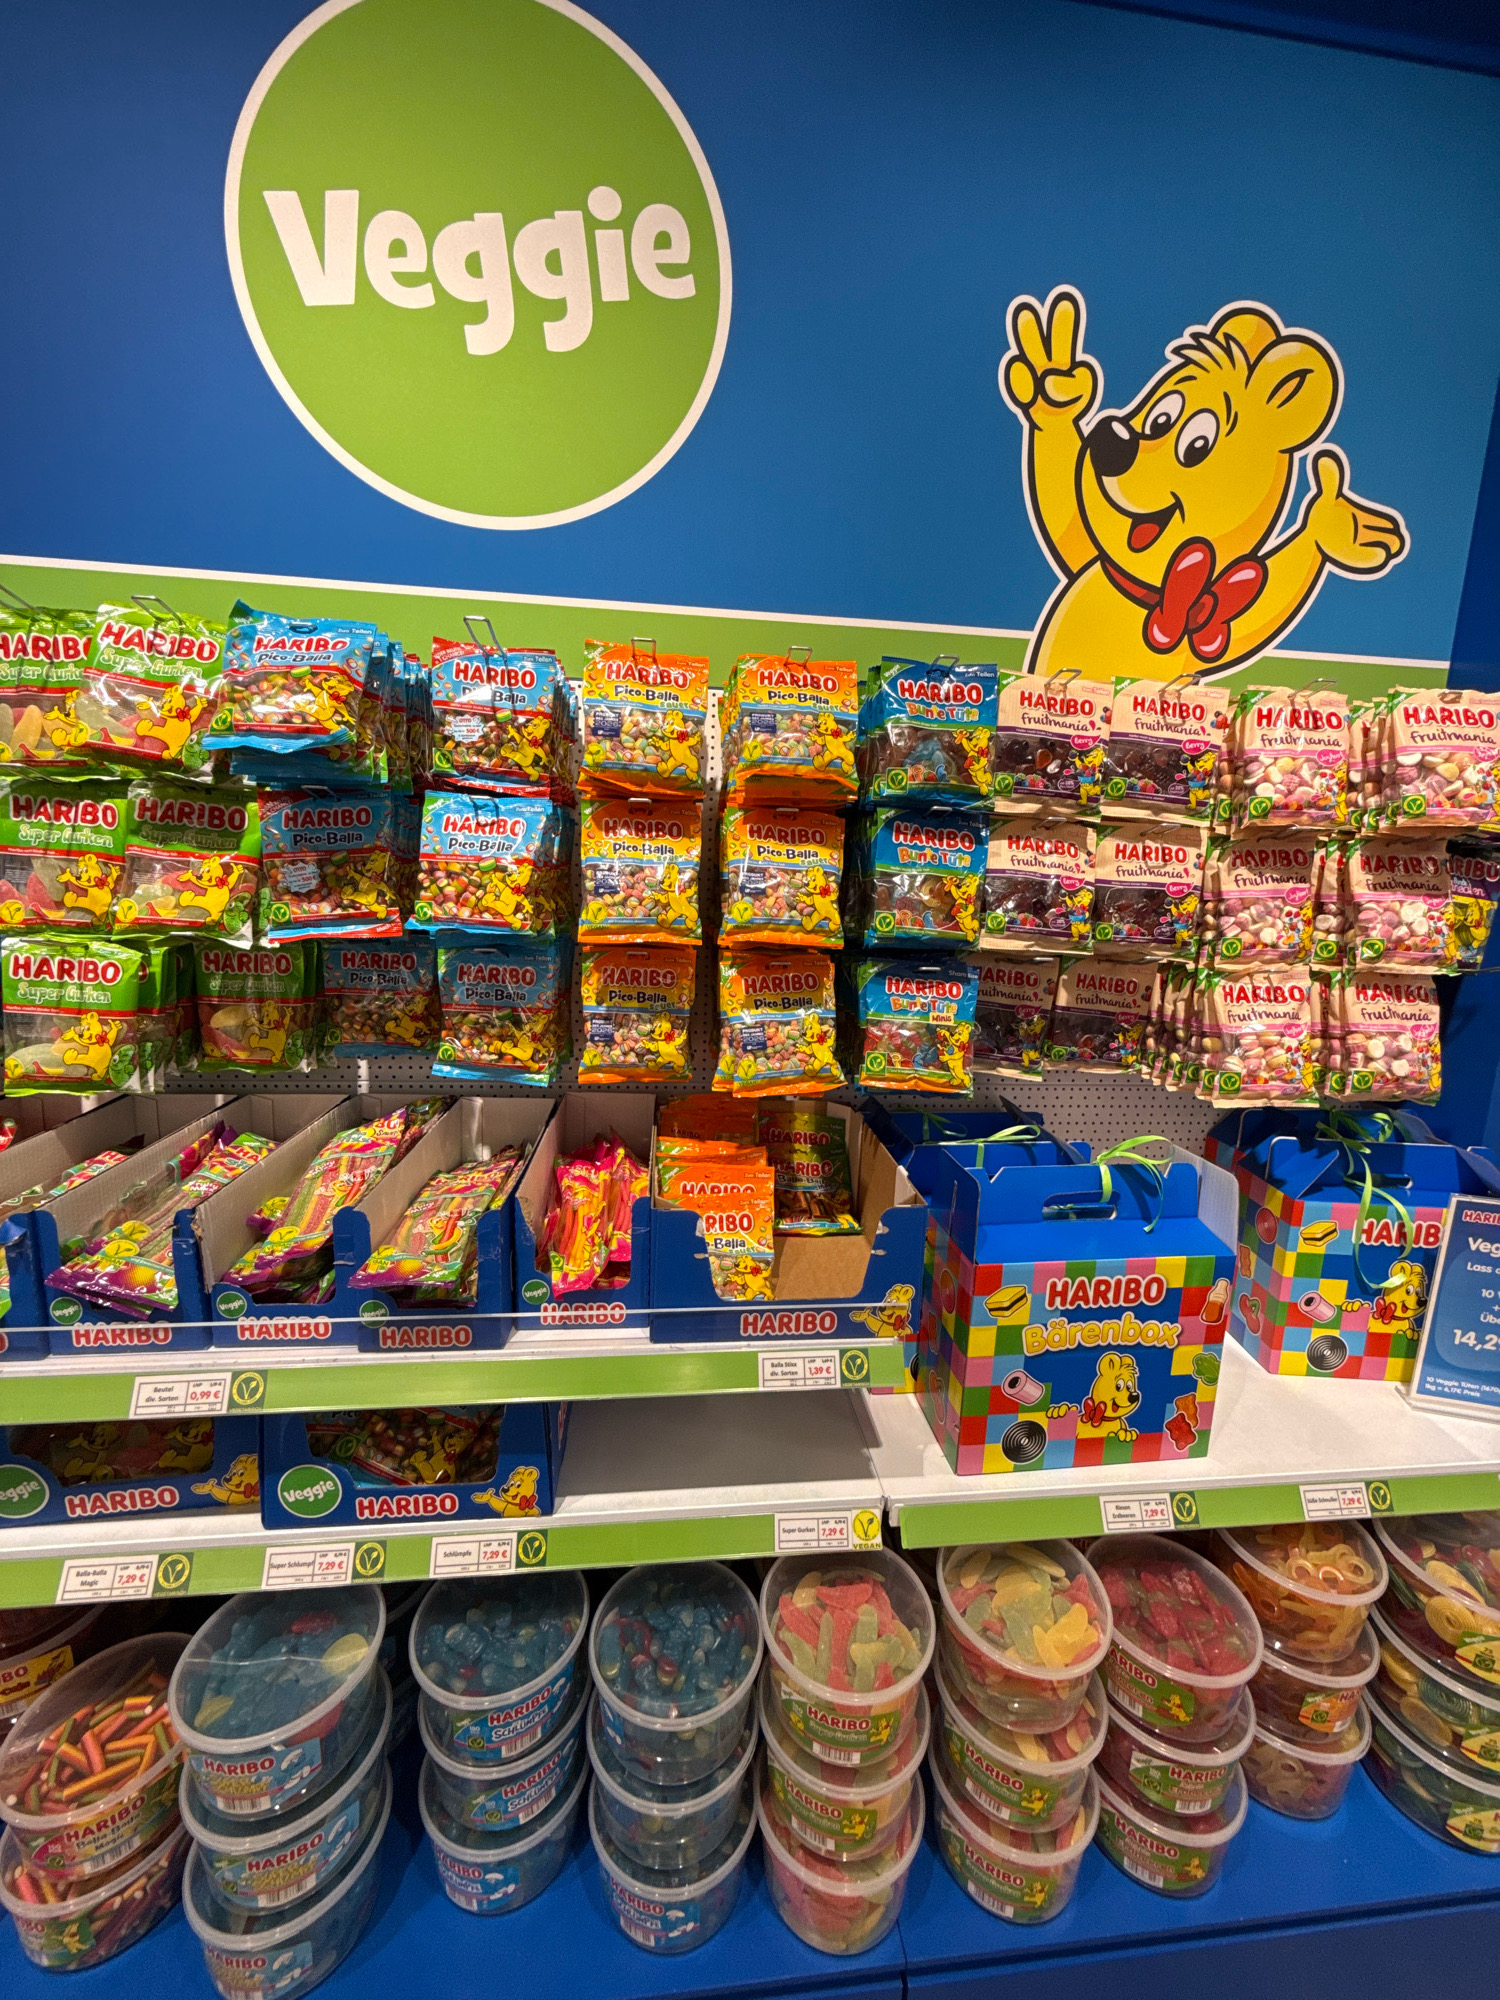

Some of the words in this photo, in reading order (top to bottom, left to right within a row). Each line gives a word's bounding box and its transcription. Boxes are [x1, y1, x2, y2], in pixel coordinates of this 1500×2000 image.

[263, 186, 696, 355] Veggie
[98, 621, 219, 662] HARIBO
[253, 636, 350, 653] HARIBO
[101, 648, 150, 672] Super
[151, 660, 202, 678] Gurken
[257, 653, 332, 663] Pico-Balla
[453, 661, 537, 689] HARIBO
[605, 661, 691, 690] HARIBO
[757, 669, 839, 694] HARIBO
[613, 684, 680, 703] Pico-Balla
[767, 690, 830, 706] Pico-Balla
[897, 679, 983, 704] HARIBO
[906, 701, 946, 720] Bunte
[947, 706, 979, 722] Tüte
[1019, 690, 1094, 717] HARIBO
[1132, 695, 1206, 722] HARIBO
[1021, 713, 1090, 732] fruitmania
[1135, 718, 1202, 736] fruitmania
[1256, 706, 1344, 731] HARIBO
[1403, 705, 1496, 729] HARIBO
[1074, 735, 1094, 746] Berry
[1185, 741, 1205, 752] Berry
[1260, 733, 1342, 748] fruitmania
[1410, 731, 1497, 746] fruitmania
[11, 794, 119, 829] HARIBO
[136, 796, 248, 831] HARIBO
[282, 806, 371, 830] HARIBO
[18, 823, 58, 844] Super
[60, 827, 113, 848] Gurken
[443, 815, 527, 837] HARIBO
[602, 818, 684, 841] HARIBO
[747, 823, 827, 846] HARIBO
[892, 820, 976, 851] HARIBO
[292, 831, 363, 847] Pico-Balla
[448, 837, 513, 853] Pico-Balla
[612, 841, 675, 856] Pico-Balla
[1007, 834, 1080, 860] HARIBO
[756, 845, 819, 861] Pico-Balla
[897, 847, 938, 865] Bunte
[939, 850, 971, 867] Tüte
[1114, 841, 1188, 865] HARIBO
[1230, 848, 1311, 871] HARIBO
[1010, 855, 1076, 874] fruitmania
[1116, 864, 1185, 880] fruitmania
[1360, 853, 1439, 877] HARIBO
[1063, 877, 1081, 889] Berry
[1169, 884, 1189, 895] Berry
[1234, 873, 1309, 888] fruitmania
[1366, 878, 1443, 893] fruitmania
[11, 953, 123, 986] HARIBO
[203, 950, 293, 976] HARIBO
[341, 950, 417, 972] HARIBO
[350, 972, 407, 986] Pico-Balla
[457, 963, 537, 987] HARIBO
[602, 966, 677, 989] HARIBO
[742, 971, 819, 996] HARIBO
[1076, 972, 1139, 995] HARIBO
[17, 982, 64, 1005] Super
[65, 985, 111, 1004] Gurken
[465, 987, 527, 1002] Pico-Balla
[608, 989, 668, 1004] Pico-Balla
[885, 976, 963, 999] HARIBO
[977, 987, 1034, 1002] ruitmania
[1222, 983, 1305, 1005] HARIBO
[1355, 982, 1430, 1004] HARIBO
[753, 996, 813, 1011] Pico-Balla
[890, 997, 928, 1012] Bunte
[929, 999, 957, 1014] Tüte
[1075, 994, 1134, 1010] fruitmania
[932, 1013, 953, 1024] Minis
[1227, 1007, 1302, 1023] fruitmania
[1361, 1007, 1432, 1022] fruitmania
[770, 1128, 831, 1146] HARIBO
[703, 1212, 754, 1234] RIBO
[1352, 1218, 1442, 1248] HARIB
[1467, 1262, 1492, 1273] Lass
[523, 1286, 548, 1298] Veggie
[1046, 1274, 1167, 1310] HARIBO
[1481, 1289, 1494, 1298] 10
[52, 1304, 79, 1318] Veggie
[218, 1299, 245, 1312] Veggie
[541, 1302, 626, 1325] HARIBO
[740, 1311, 837, 1337] HARIBO
[1480, 1311, 1500, 1324] Übe
[73, 1323, 172, 1347] HARIBO
[237, 1318, 331, 1341] HARIBO
[380, 1325, 472, 1348] HARIBO
[1022, 1311, 1182, 1356] Bärenbox
[808, 1367, 824, 1376] 1,39
[825, 1366, 831, 1374] €
[1435, 1377, 1458, 1387] Veggie
[1461, 1380, 1479, 1389] Tüten
[1463, 1389, 1480, 1397] Preis
[190, 1391, 211, 1401] 0,99
[213, 1390, 220, 1399] €
[0, 1480, 41, 1502] eggie
[65, 1485, 180, 1518] HARIBO
[283, 1480, 336, 1503] Veggie
[1341, 1498, 1355, 1506] 7,29
[1356, 1497, 1362, 1505] €
[355, 1492, 459, 1520] HARIBO
[1144, 1509, 1158, 1518] 7,29
[821, 1528, 837, 1537] 7,29
[317, 1561, 336, 1572] 7,29
[337, 1560, 344, 1570] €
[482, 1551, 499, 1560] 7,29
[501, 1550, 508, 1558] €
[75, 1569, 107, 1577] Balla-Balla
[117, 1574, 137, 1585] 7,29
[138, 1574, 146, 1583] €
[1108, 1646, 1158, 1689] ARIBO
[489, 1686, 551, 1726] HARIBO
[807, 1705, 871, 1731] HARIBO
[204, 1756, 275, 1777] HARIBO
[503, 1752, 562, 1799] HARIBO
[964, 1743, 1025, 1792] HARIBO
[1169, 1765, 1227, 1783] HARIBO
[785, 1775, 842, 1820] HARIBO
[65, 1795, 146, 1843] HARIBO
[1114, 1813, 1180, 1859] HARIBO
[247, 1832, 325, 1873] HARIBO
[963, 1843, 1025, 1888] HARIBO
